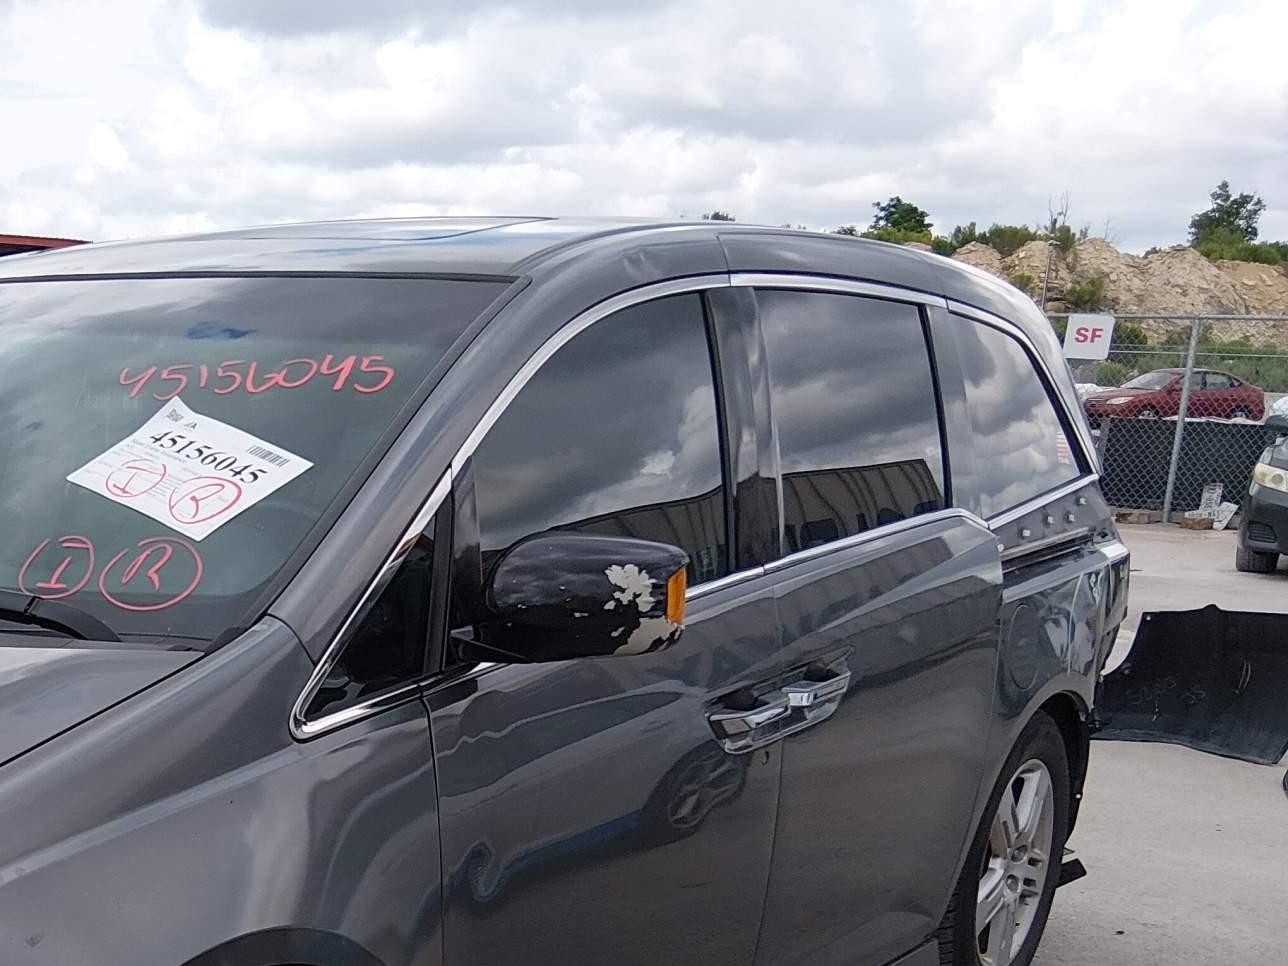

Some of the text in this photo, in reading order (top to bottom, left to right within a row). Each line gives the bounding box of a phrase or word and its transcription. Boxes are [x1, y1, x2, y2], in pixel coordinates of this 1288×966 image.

[1074, 326, 1104, 344] SF
[118, 353, 396, 402] 45156045
[149, 430, 269, 485] 45156045
